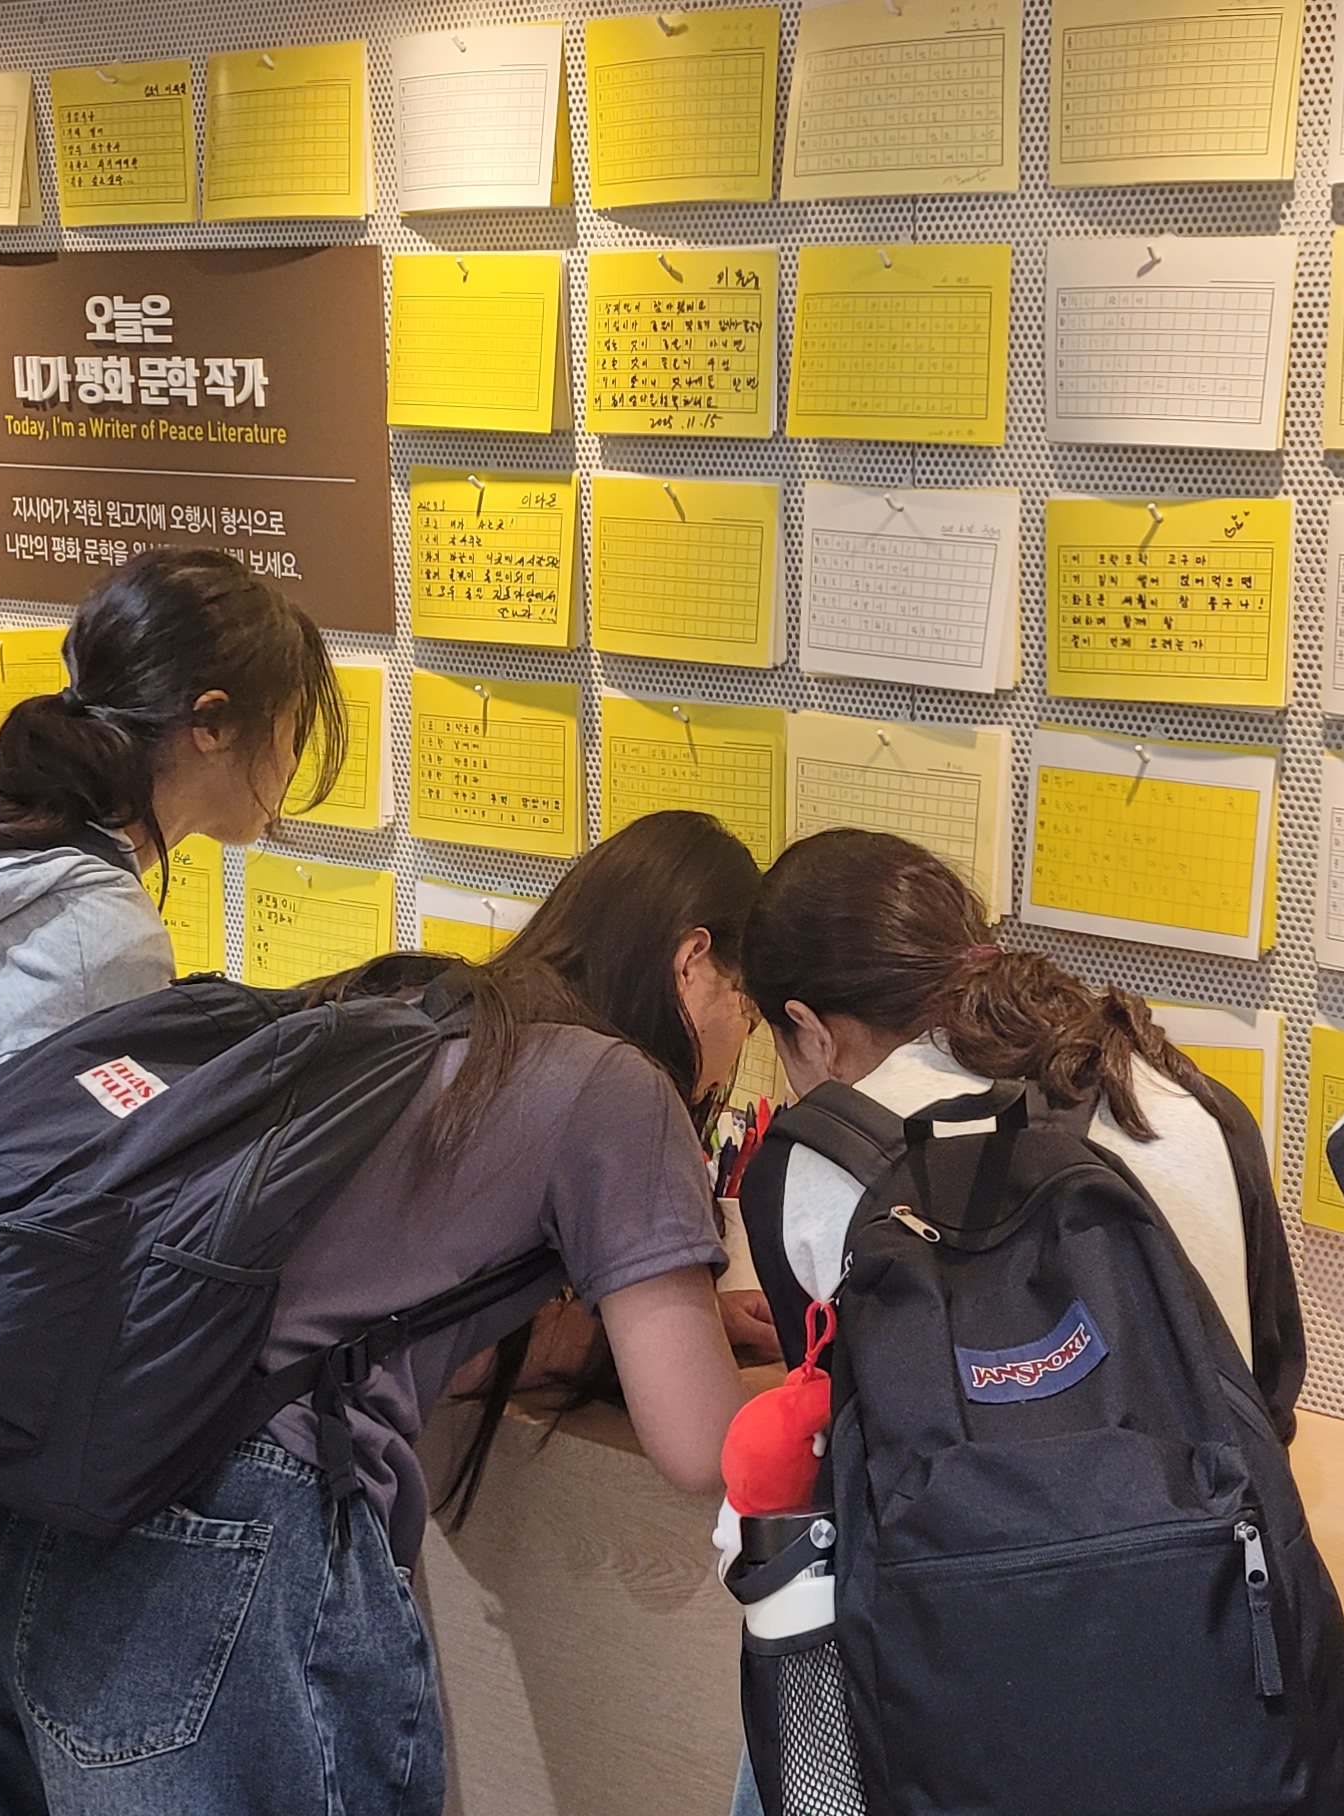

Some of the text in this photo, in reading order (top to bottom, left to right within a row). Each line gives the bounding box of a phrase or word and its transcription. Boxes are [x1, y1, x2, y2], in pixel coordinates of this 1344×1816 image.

[85, 294, 174, 344] 오늘은
[13, 355, 270, 408] 내가 평화 문학 작가
[5, 414, 288, 445] Today, I'm a Writer of Peace Literature
[11, 496, 287, 537] 지시어가 적힌 원고지에 오행시 형식으로
[6, 532, 50, 562] 나만의
[51, 536, 82, 564] 평화
[84, 538, 128, 568] 문학을
[249, 549, 303, 581] 보세요.
[1167, 553, 1207, 566] 고구마
[971, 1321, 1089, 1388] JANSPORT
